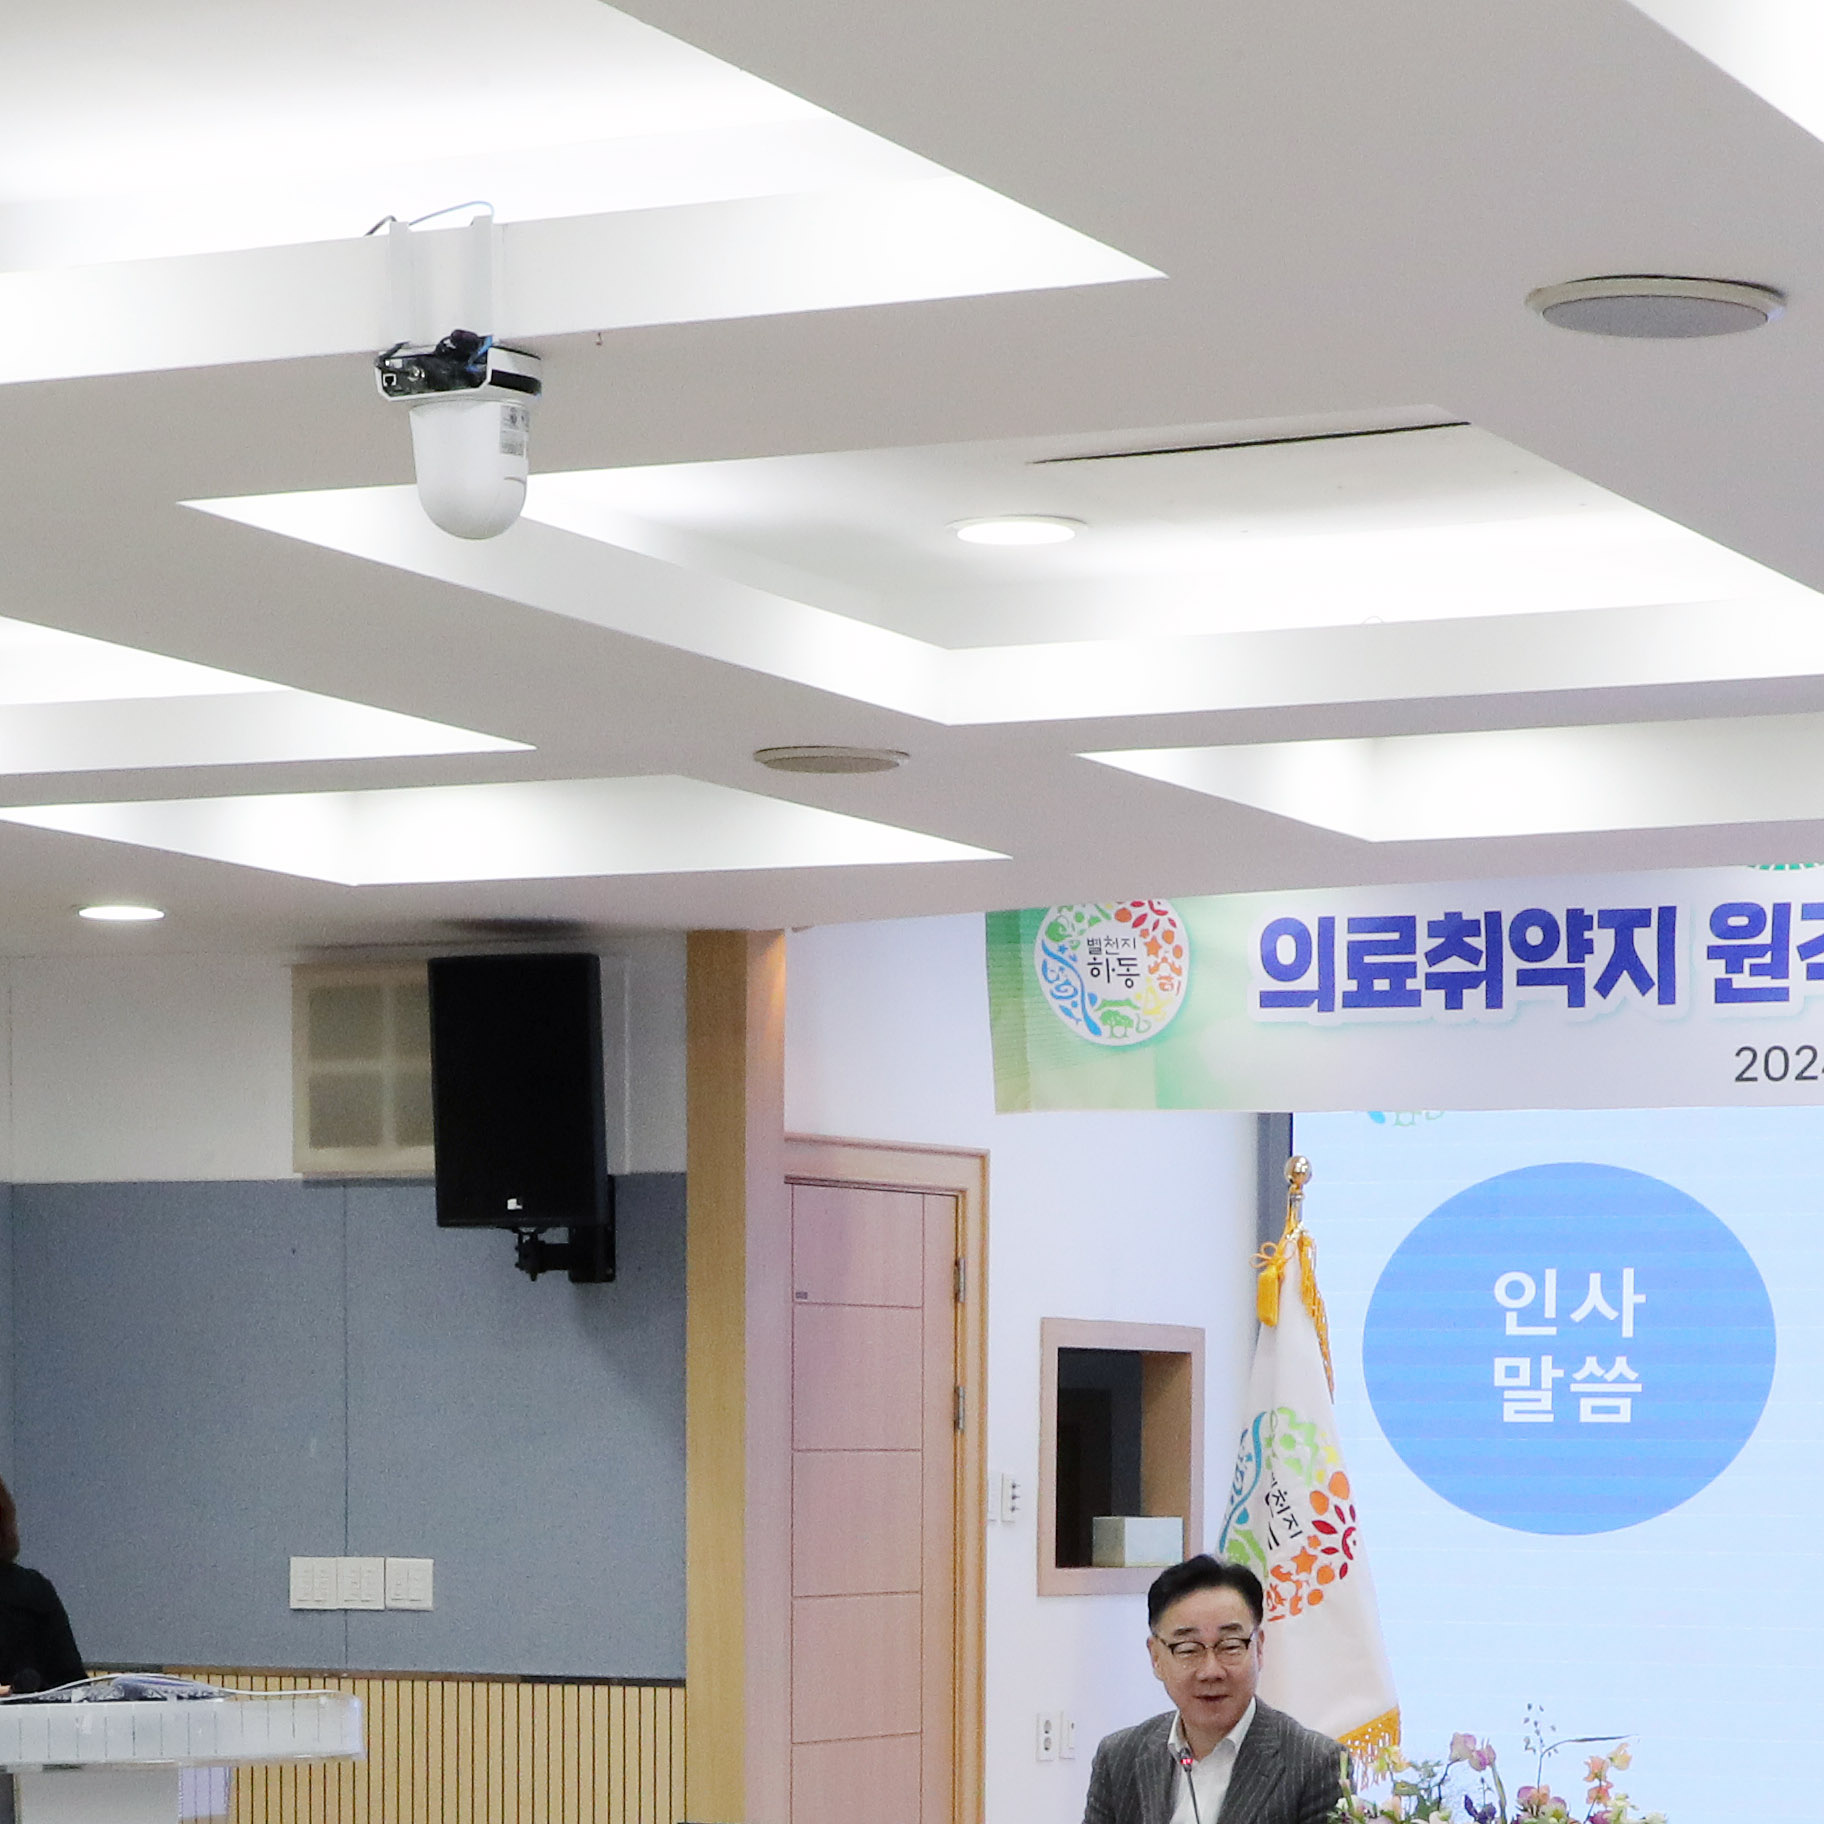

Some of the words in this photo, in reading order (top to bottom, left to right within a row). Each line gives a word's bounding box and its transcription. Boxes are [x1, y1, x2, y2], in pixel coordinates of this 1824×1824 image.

[1086, 956, 1141, 988] 하동
[1259, 904, 1678, 1014] 의료취약지
[1493, 1267, 1647, 1339] 인사
[1493, 1354, 1644, 1423] 말씀
